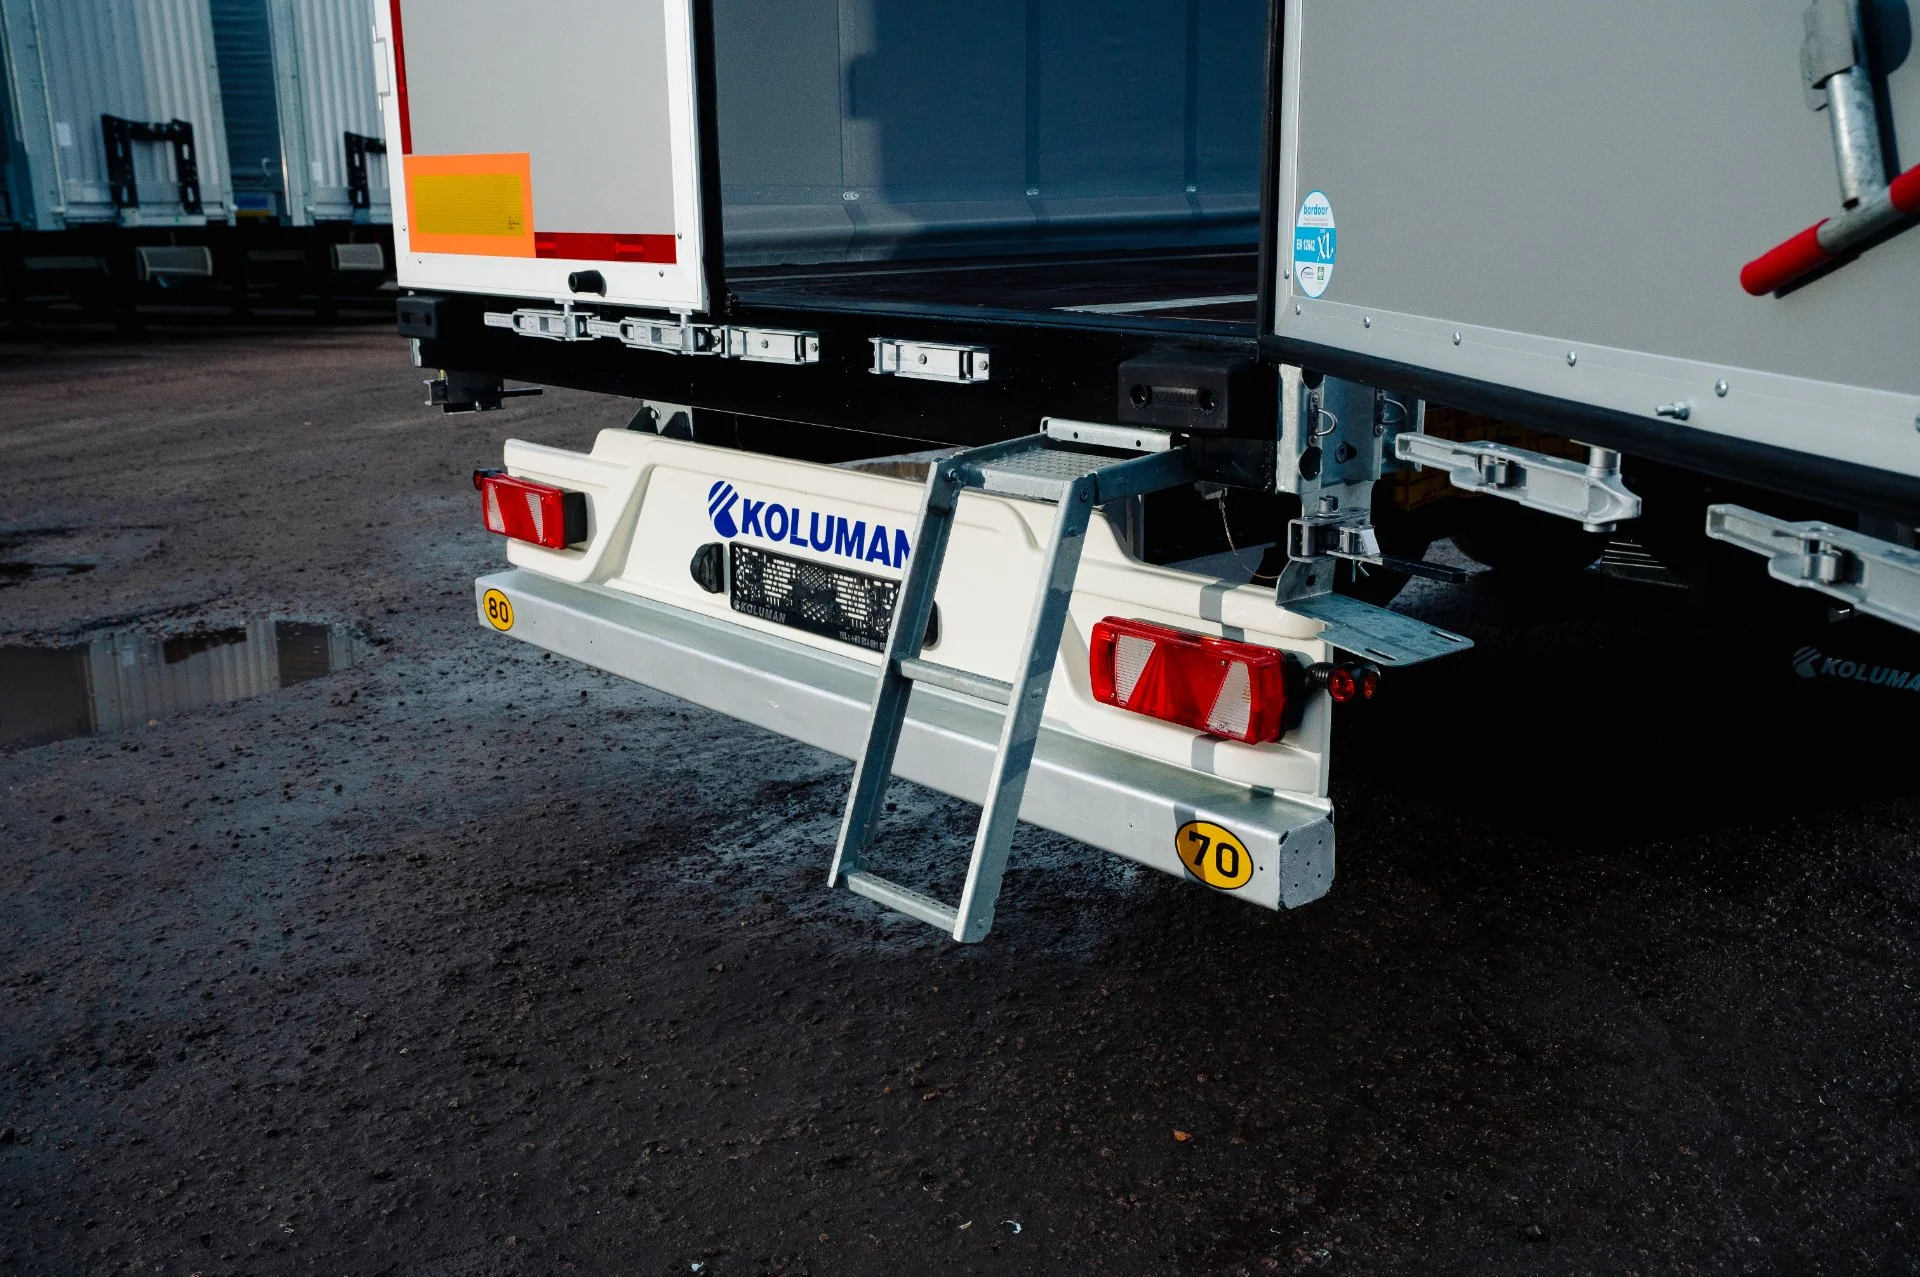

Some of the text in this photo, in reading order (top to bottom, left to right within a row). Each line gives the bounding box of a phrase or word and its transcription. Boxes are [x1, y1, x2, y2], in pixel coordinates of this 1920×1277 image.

[1303, 204, 1329, 215] bordoor
[489, 597, 508, 623] 80
[740, 601, 786, 623] KOLUMAN
[1189, 829, 1239, 878] 70
